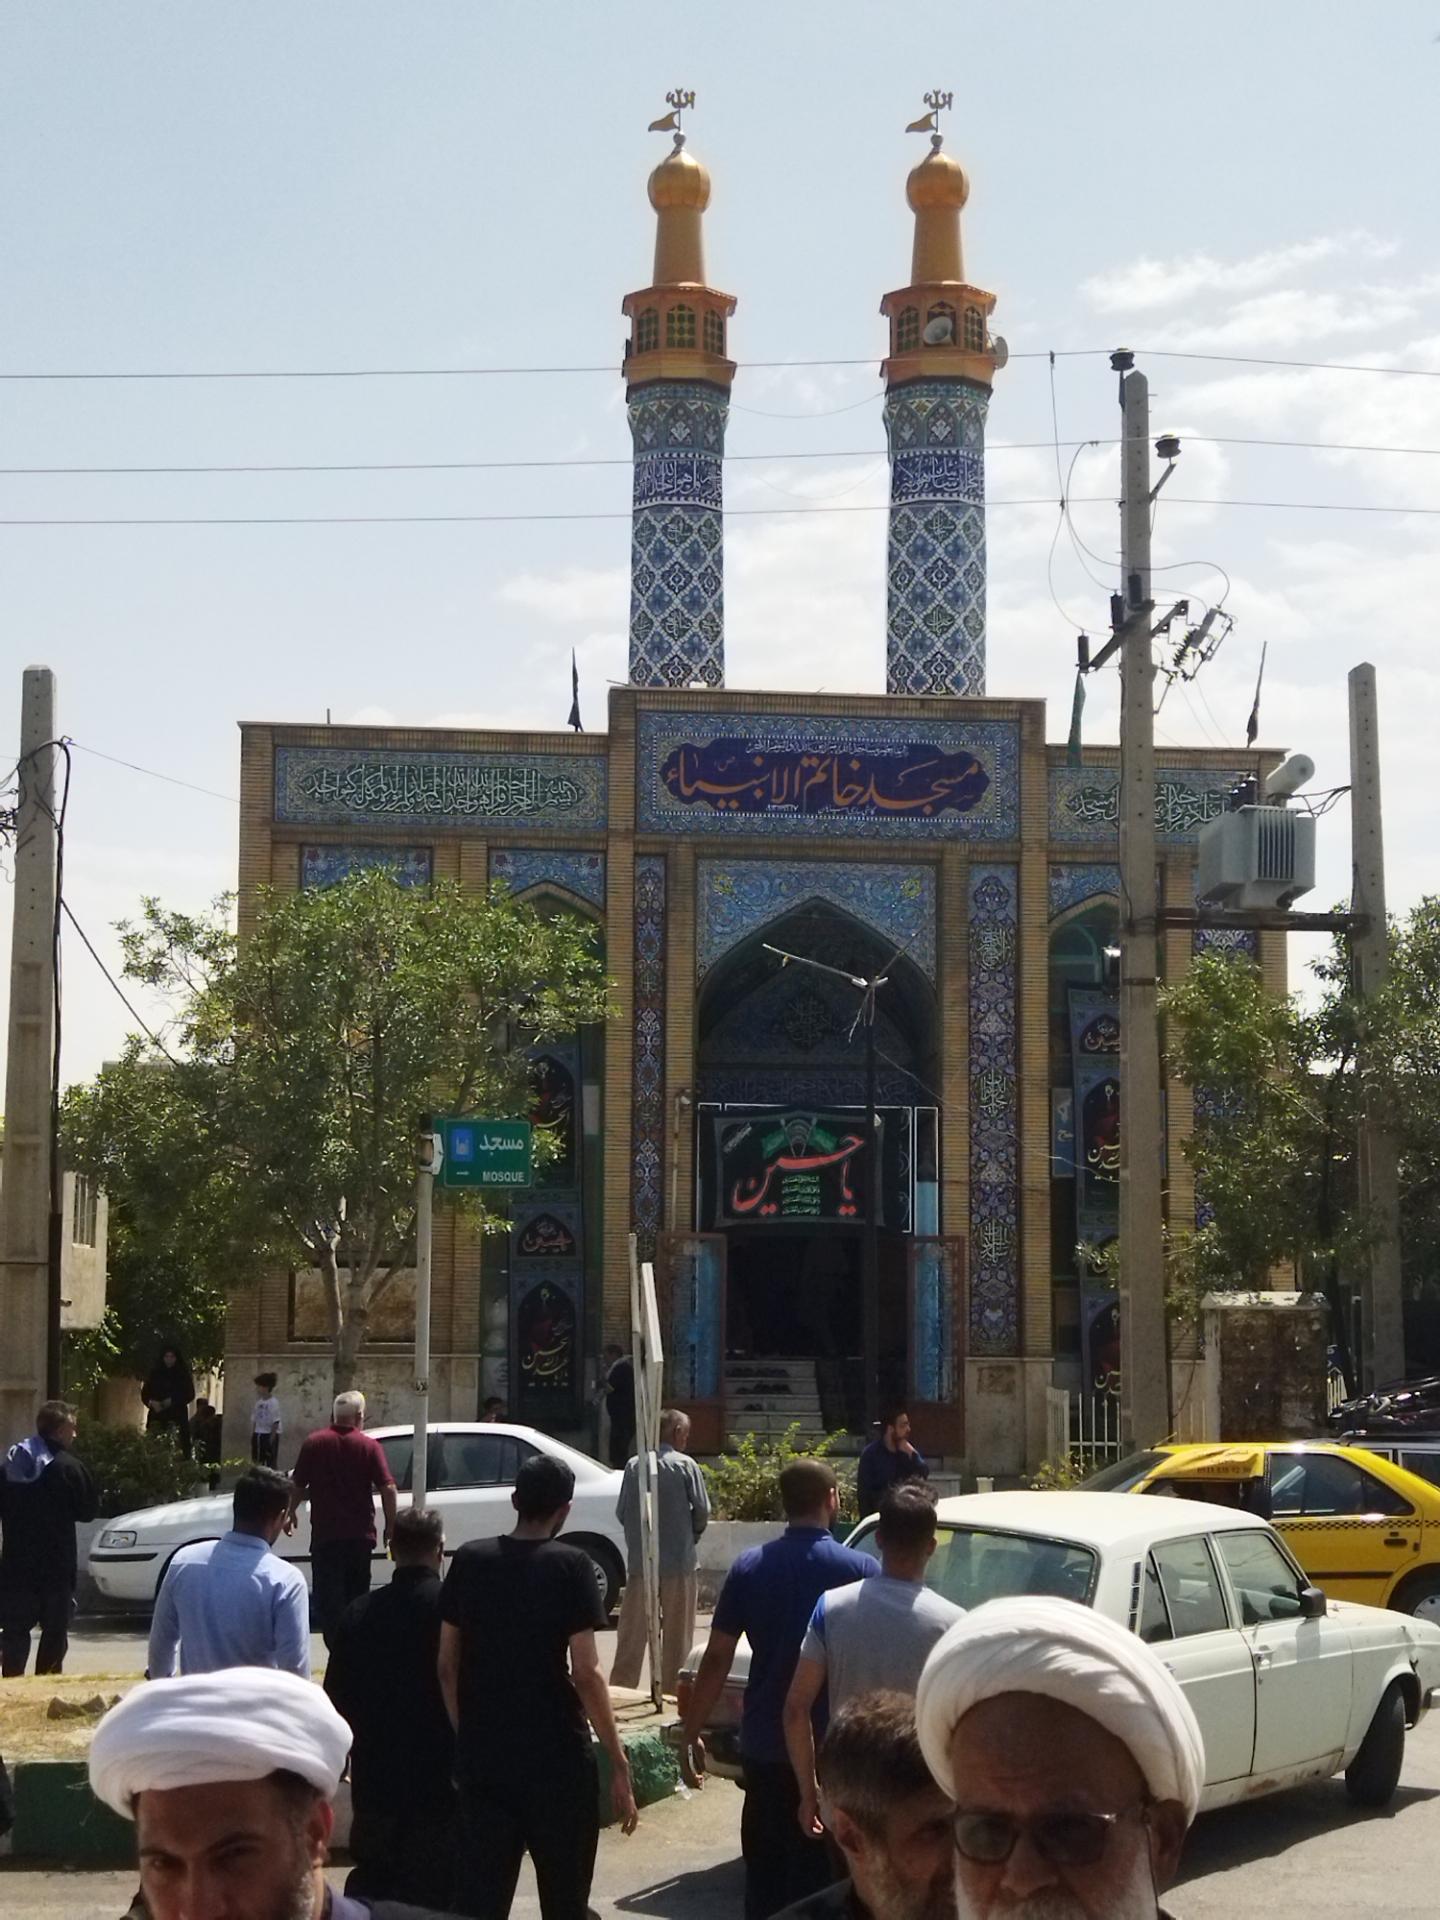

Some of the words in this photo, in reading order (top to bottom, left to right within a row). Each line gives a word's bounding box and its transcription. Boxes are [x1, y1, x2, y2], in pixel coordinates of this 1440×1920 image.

[803, 755, 866, 812] خاتم
[867, 760, 980, 815] مسجد
[479, 1134, 524, 1156] مسجد
[482, 1171, 525, 1182] MOSQUE
[731, 1135, 866, 1216] حسین
[838, 1159, 858, 1216] یا
